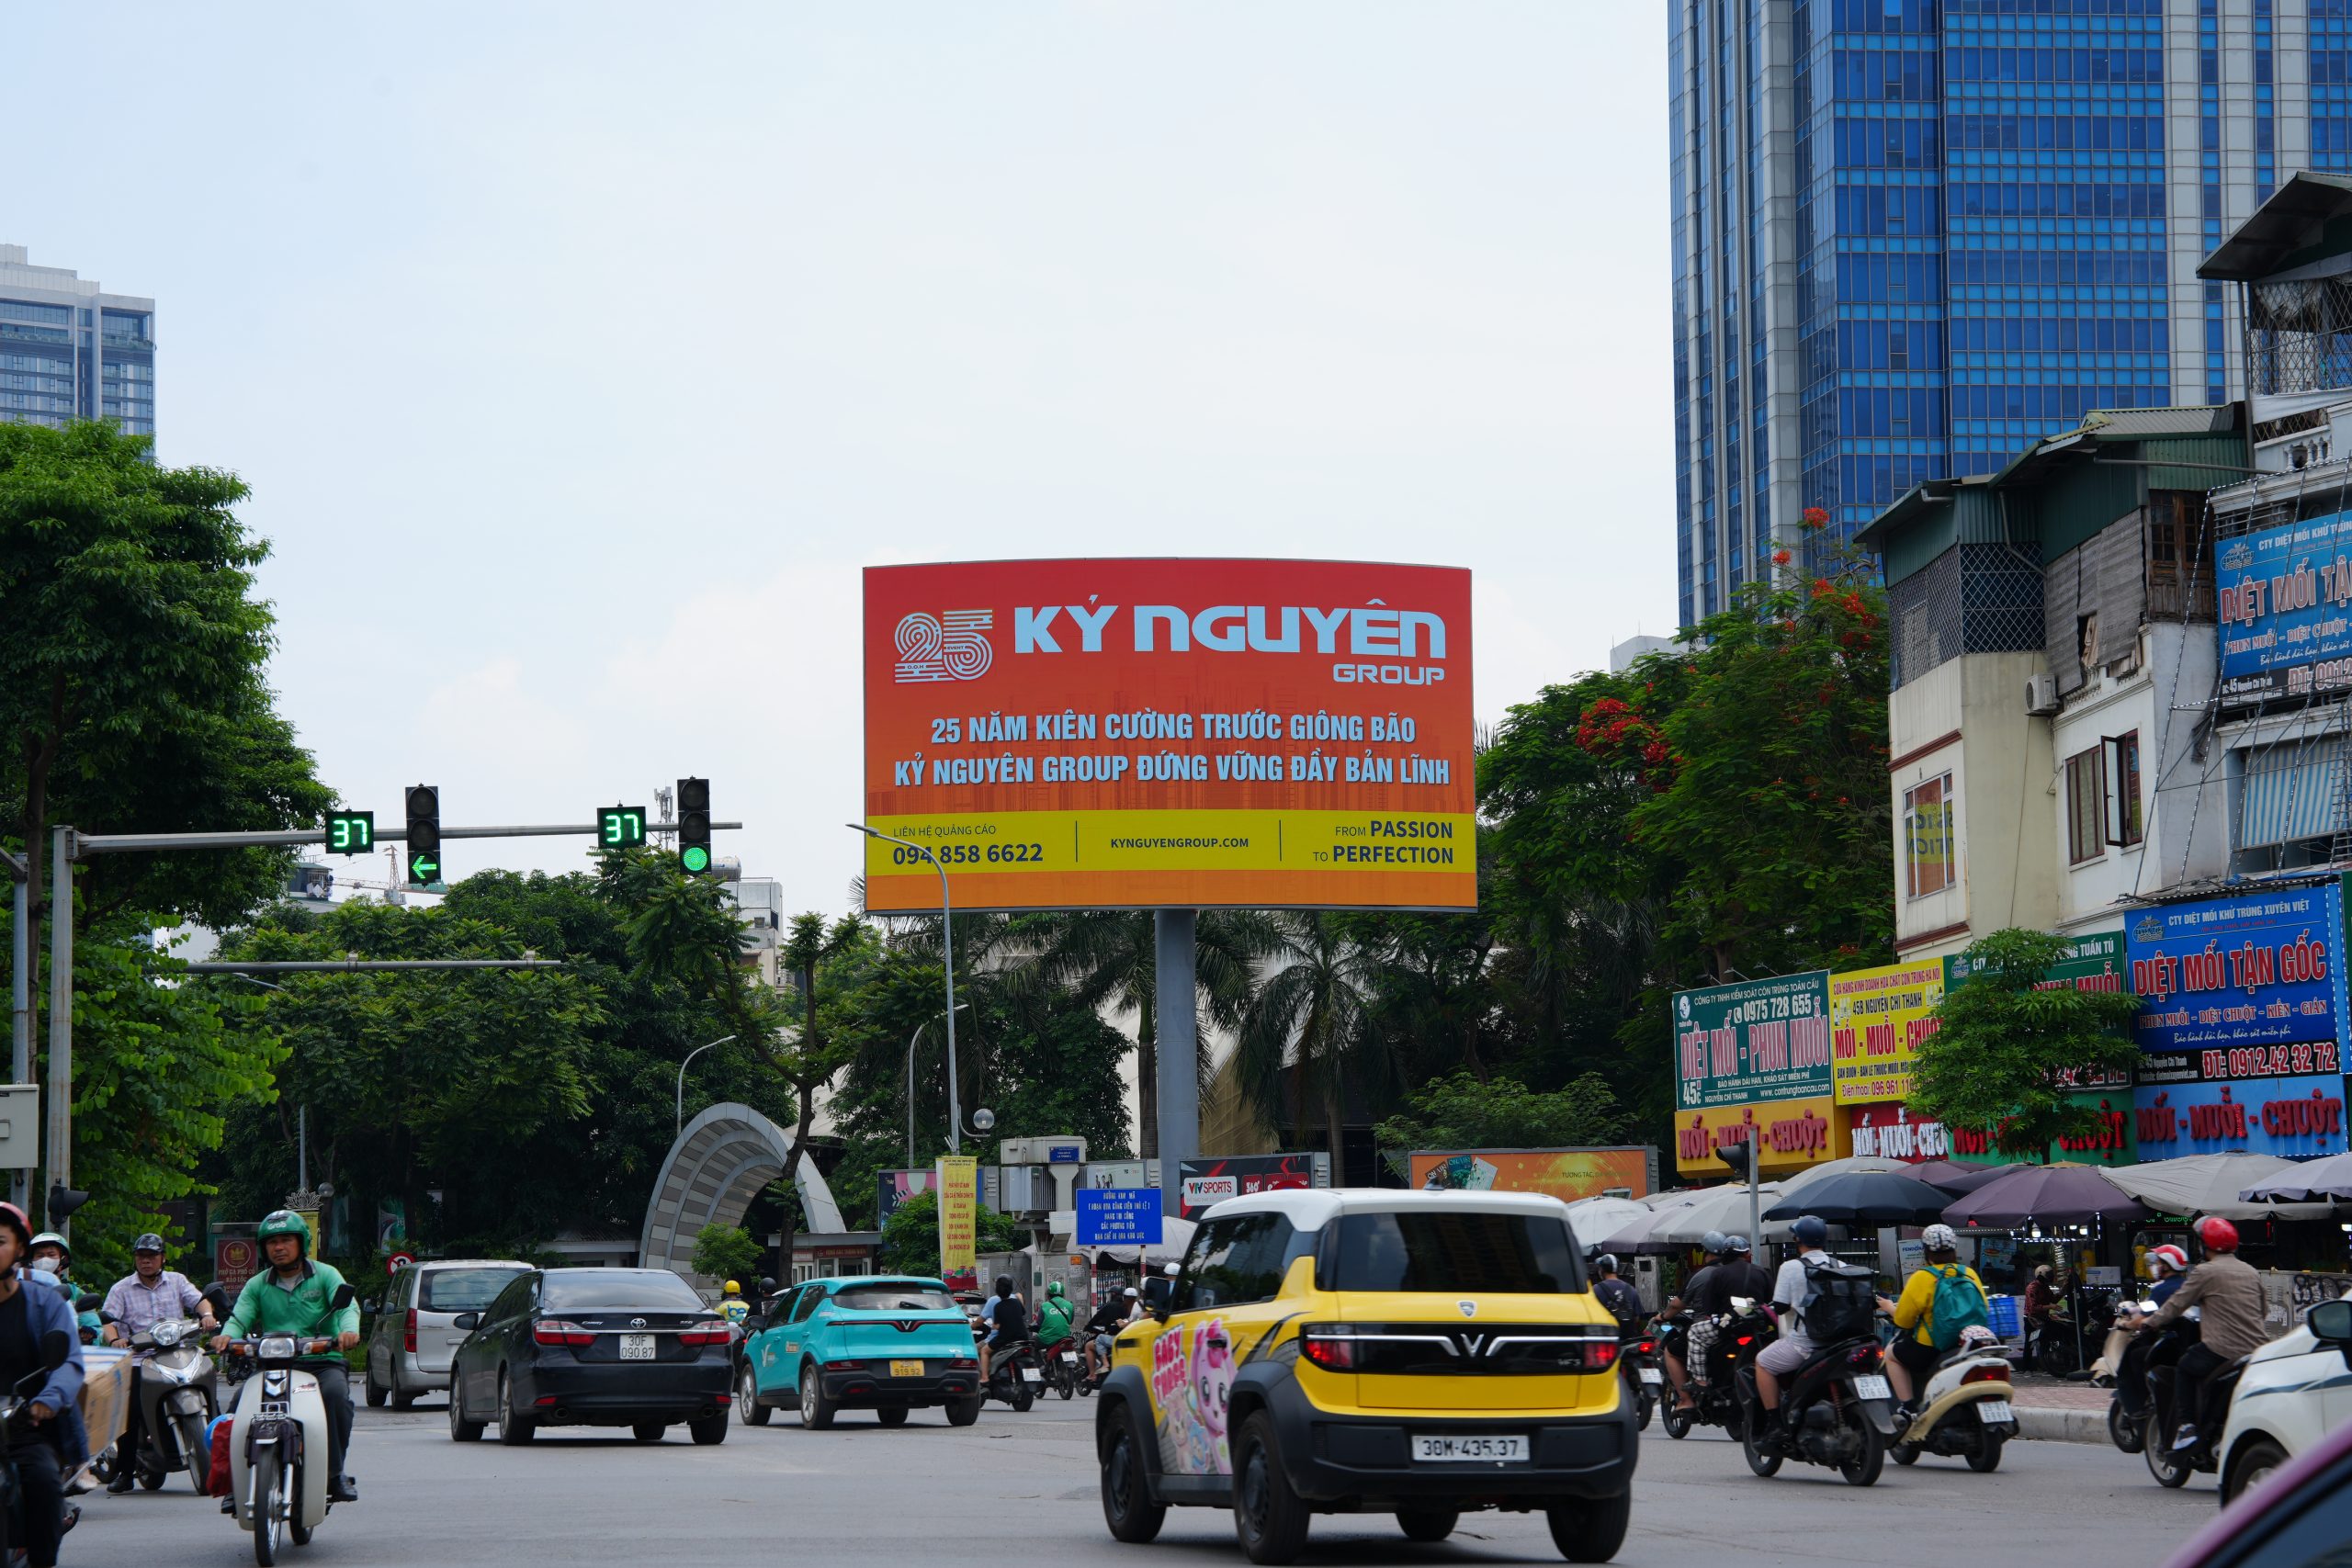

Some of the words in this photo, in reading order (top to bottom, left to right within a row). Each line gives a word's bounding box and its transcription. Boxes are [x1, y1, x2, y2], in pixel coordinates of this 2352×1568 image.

[2259, 539, 2273, 551] CTY
[2221, 575, 2267, 626] DIỆT
[2272, 557, 2316, 614] MỐI
[2322, 555, 2352, 608] TẬ
[895, 609, 992, 682] 25
[1332, 663, 1445, 685] GROUP
[931, 718, 961, 743] 25
[968, 711, 1028, 742] NĂM
[1036, 709, 1096, 740] KIÊN
[1104, 707, 1193, 739] CƯỜNG
[1200, 708, 1282, 740] TRƯỚC
[1290, 709, 1363, 741] GIÔNG
[1371, 712, 1416, 742] BÃO
[894, 751, 926, 786] KỶ
[933, 752, 1034, 785] NGUYÊN
[1043, 755, 1129, 782] GROUP
[1136, 750, 1208, 781] ĐỨNG
[1216, 750, 1283, 781] VỮNG
[1290, 748, 1339, 782] ĐẦY
[1345, 749, 1393, 784] BẢN
[1400, 753, 1450, 784] LĨNH
[333, 819, 368, 847] 37
[605, 814, 639, 843] 37
[893, 826, 915, 838] LIÊN
[919, 825, 933, 838] HỆ
[934, 823, 972, 838] QUẢNG
[975, 823, 996, 835] CÁO
[1335, 826, 1366, 837] FROM
[1370, 820, 1453, 839] PASSION
[893, 845, 933, 864] 094
[939, 844, 980, 863] 858
[987, 843, 1044, 863] 6622
[1110, 836, 1250, 850] KYNGUYENGROUP.COM
[1313, 852, 1329, 862] TO
[1333, 845, 1453, 863] PERFECTION
[2168, 915, 2182, 926] CTY
[2184, 912, 2200, 926] DIỆT
[2202, 908, 2217, 922] MỐI
[2219, 904, 2235, 920] KHỬ
[2236, 903, 2263, 918] TRÙNG
[2264, 900, 2290, 916] XUYÊN
[2292, 898, 2310, 913] VIỆT
[2133, 950, 2177, 1002] DIỆT
[2183, 939, 2226, 992] MỐI
[2230, 941, 2275, 995] TẬN
[2279, 929, 2326, 983] GỐC
[1694, 996, 1710, 1006] CÔNG
[1711, 996, 1716, 1004] TY
[1717, 993, 1730, 1002] TNHH
[1731, 989, 1743, 999] KIỂM
[1744, 987, 1758, 998] SOÁT
[1758, 985, 1771, 996] CÔN
[1771, 983, 1789, 995] TRÙNG
[1791, 980, 1805, 992] TOÀN
[1743, 999, 1768, 1021] 0975
[1770, 996, 1790, 1019] 728
[1792, 993, 1811, 1015] 655
[1853, 999, 1863, 1016] 45B
[1866, 994, 1888, 1014] NGUYỄN
[1891, 991, 1901, 1010] CHÍ
[1902, 992, 1922, 1008] THANH
[2140, 1014, 2165, 1029] PHUN
[2165, 1007, 2190, 1027] MUỖI
[2199, 1008, 2222, 1026] DIỆT
[2223, 1004, 2256, 1023] CHUỘT
[2301, 997, 2328, 1016] GIÁN
[1679, 1021, 1708, 1089] DIỆT
[1711, 1010, 1738, 1077] MỐI
[1748, 1021, 1788, 1073] PHUN
[1790, 996, 1829, 1069] MUỖI
[1835, 1018, 1856, 1058] MỐI
[1866, 1015, 1895, 1055] MUỖI
[2202, 1050, 2227, 1078] ĐT:
[2229, 1045, 2290, 1077] 0912.42
[2291, 1043, 2312, 1073] 32
[2313, 1042, 2336, 1071] 72
[1728, 1077, 1741, 1087] HÀNH
[1871, 1081, 1884, 1095] 096
[1886, 1079, 1899, 1094] 961
[1705, 1090, 1724, 1103] NGUYỄN
[1724, 1090, 1732, 1101] CHÍ
[1733, 1091, 1747, 1101] THANH
[2135, 1091, 2177, 1141] MỐI
[2261, 1089, 2342, 1145] CHUỘT
[1679, 1115, 1709, 1158] MỐI
[1770, 1109, 1828, 1157] CHUỘT
[1852, 1113, 1875, 1157] MỐI
[1879, 1108, 1915, 1156] MUỖI
[267, 1221, 287, 1230] Grab
[727, 1304, 746, 1317] be
[621, 1347, 653, 1359] 090.87
[628, 1336, 646, 1347] 30F
[1153, 1325, 1183, 1371] BABY
